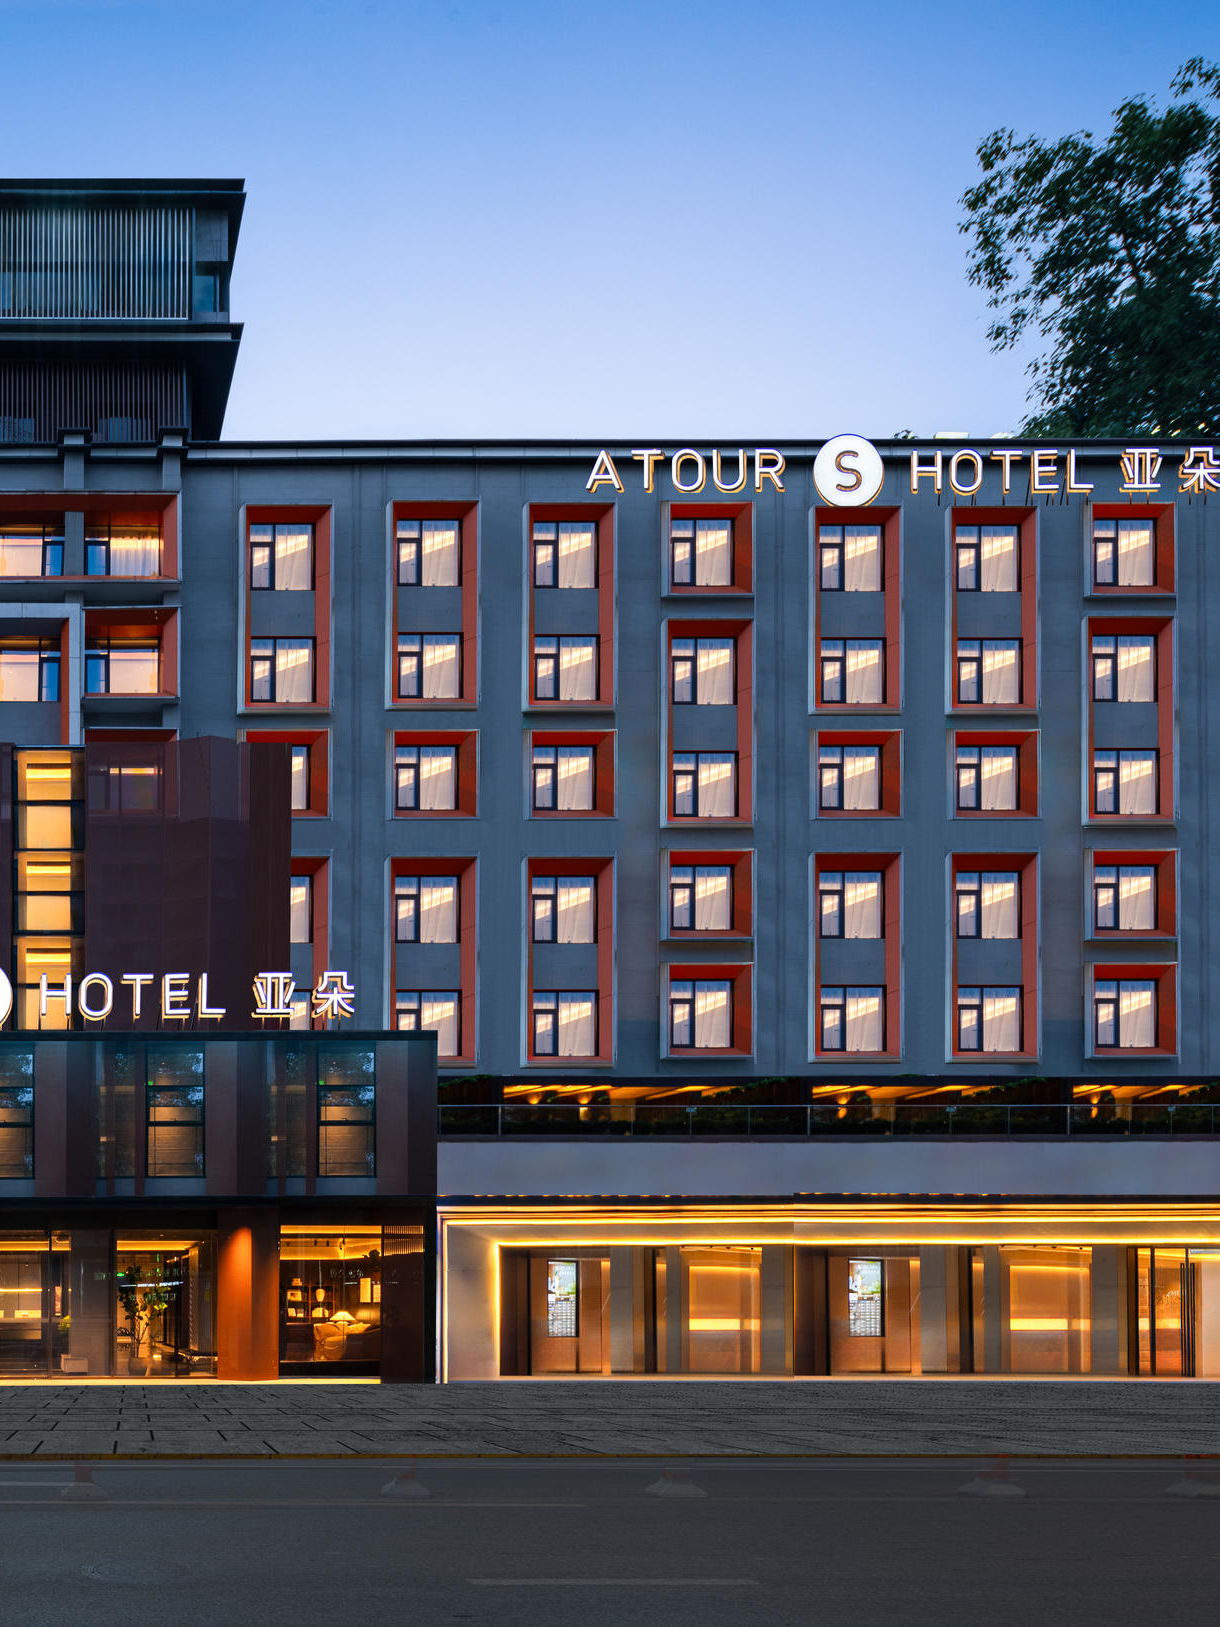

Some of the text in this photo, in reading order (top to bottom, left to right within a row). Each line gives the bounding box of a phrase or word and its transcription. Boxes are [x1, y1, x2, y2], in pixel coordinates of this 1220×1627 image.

[585, 446, 1220, 494] ATOUR S HOTEL 亚朵
[40, 972, 226, 1020] HOTEL
[251, 971, 355, 1019] 亚朵
